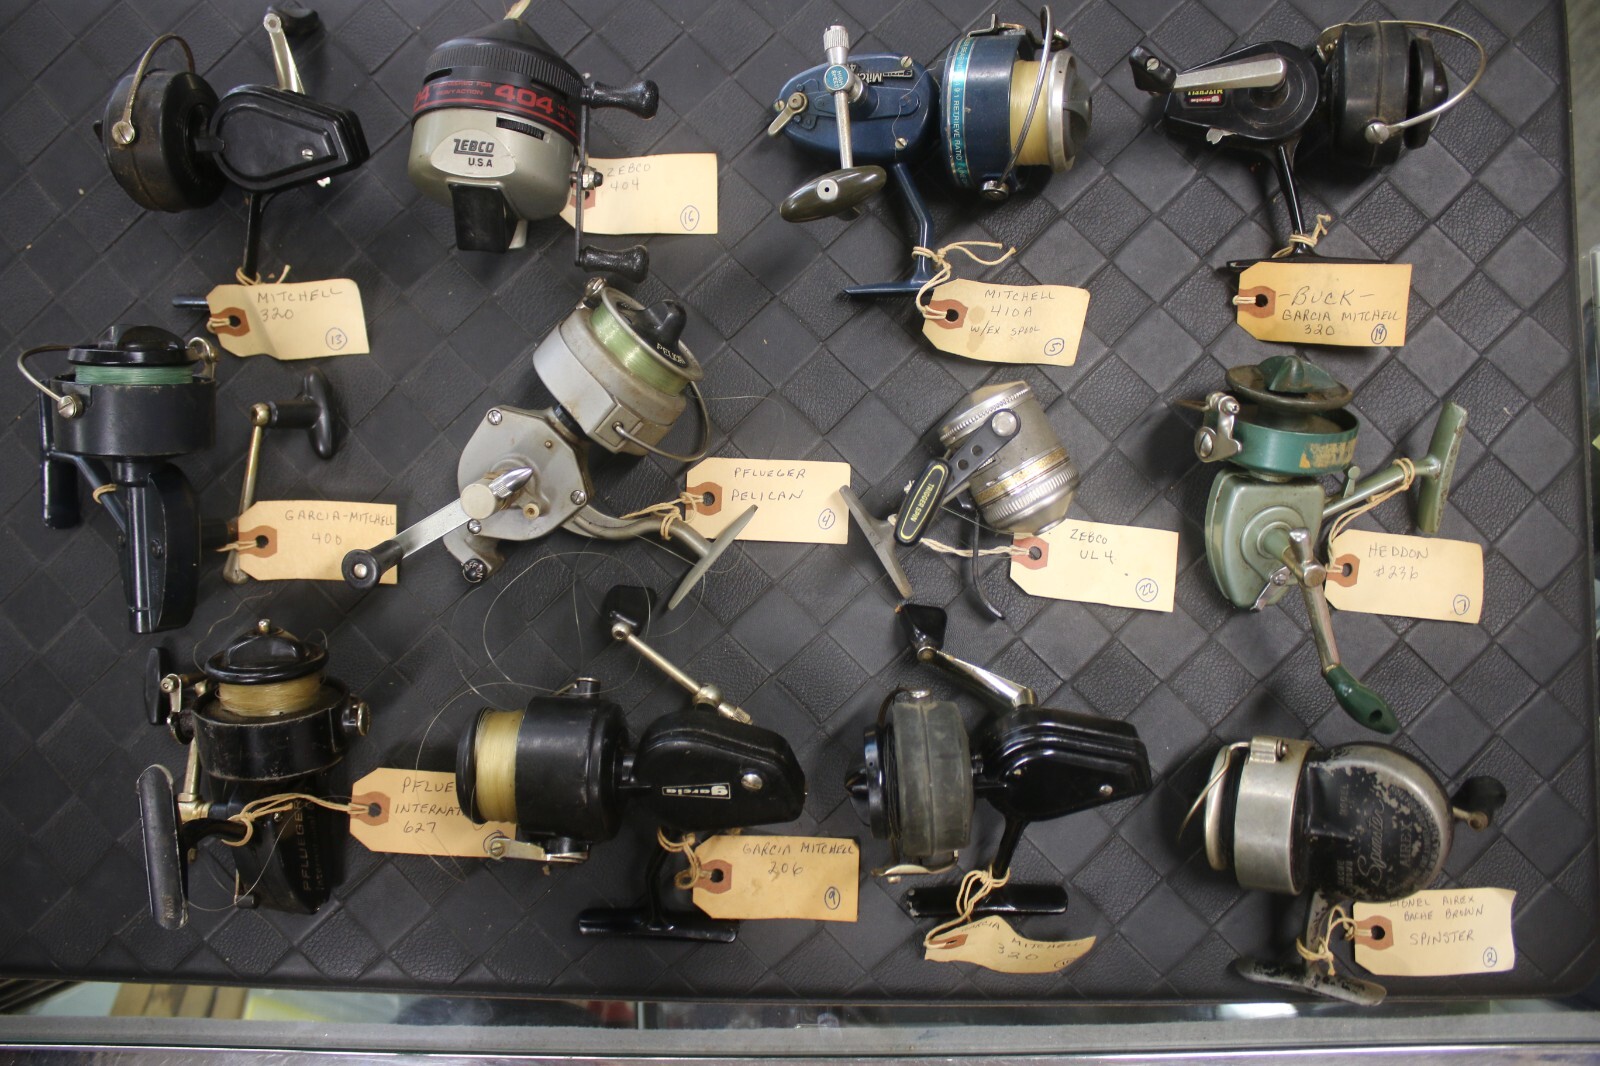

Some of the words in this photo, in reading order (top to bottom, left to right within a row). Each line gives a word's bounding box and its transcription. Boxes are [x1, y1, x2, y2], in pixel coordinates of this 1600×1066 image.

[858, 72, 884, 84] Mitc
[494, 84, 554, 115] 404
[453, 138, 495, 157] ZEBCO
[954, 139, 963, 161] RATIO
[606, 162, 651, 178] ZEBCO
[610, 178, 640, 192] 404
[257, 287, 343, 304] MITCHELL
[984, 289, 1056, 300] MITCHELL
[260, 307, 294, 322] 320
[1282, 309, 1331, 322] GARCIA
[1341, 309, 1400, 321] MITCHELL
[1304, 323, 1335, 336] 320
[734, 467, 806, 479] PFLUEGER
[731, 488, 804, 502] PELICAN
[918, 483, 935, 508] TRIGGER
[910, 506, 922, 522] SPIN
[311, 532, 342, 546] 400
[1069, 528, 1108, 545] ZEBCO
[1368, 541, 1429, 559] HEDDON
[402, 776, 455, 794] PFLUE
[394, 803, 464, 817] INTERNAT
[403, 820, 437, 834] 627
[743, 841, 791, 857] GARCIA
[800, 841, 854, 855] MITCHELL
[1357, 799, 1387, 886] Spinster
[1400, 820, 1412, 867] AIREX
[768, 861, 803, 877] 206
[1389, 897, 1431, 908] LIONEL
[1442, 895, 1475, 905] AIREX
[1404, 910, 1433, 922] BACHE
[1445, 904, 1484, 918] BROWN
[1409, 929, 1475, 946] SPINSTER
